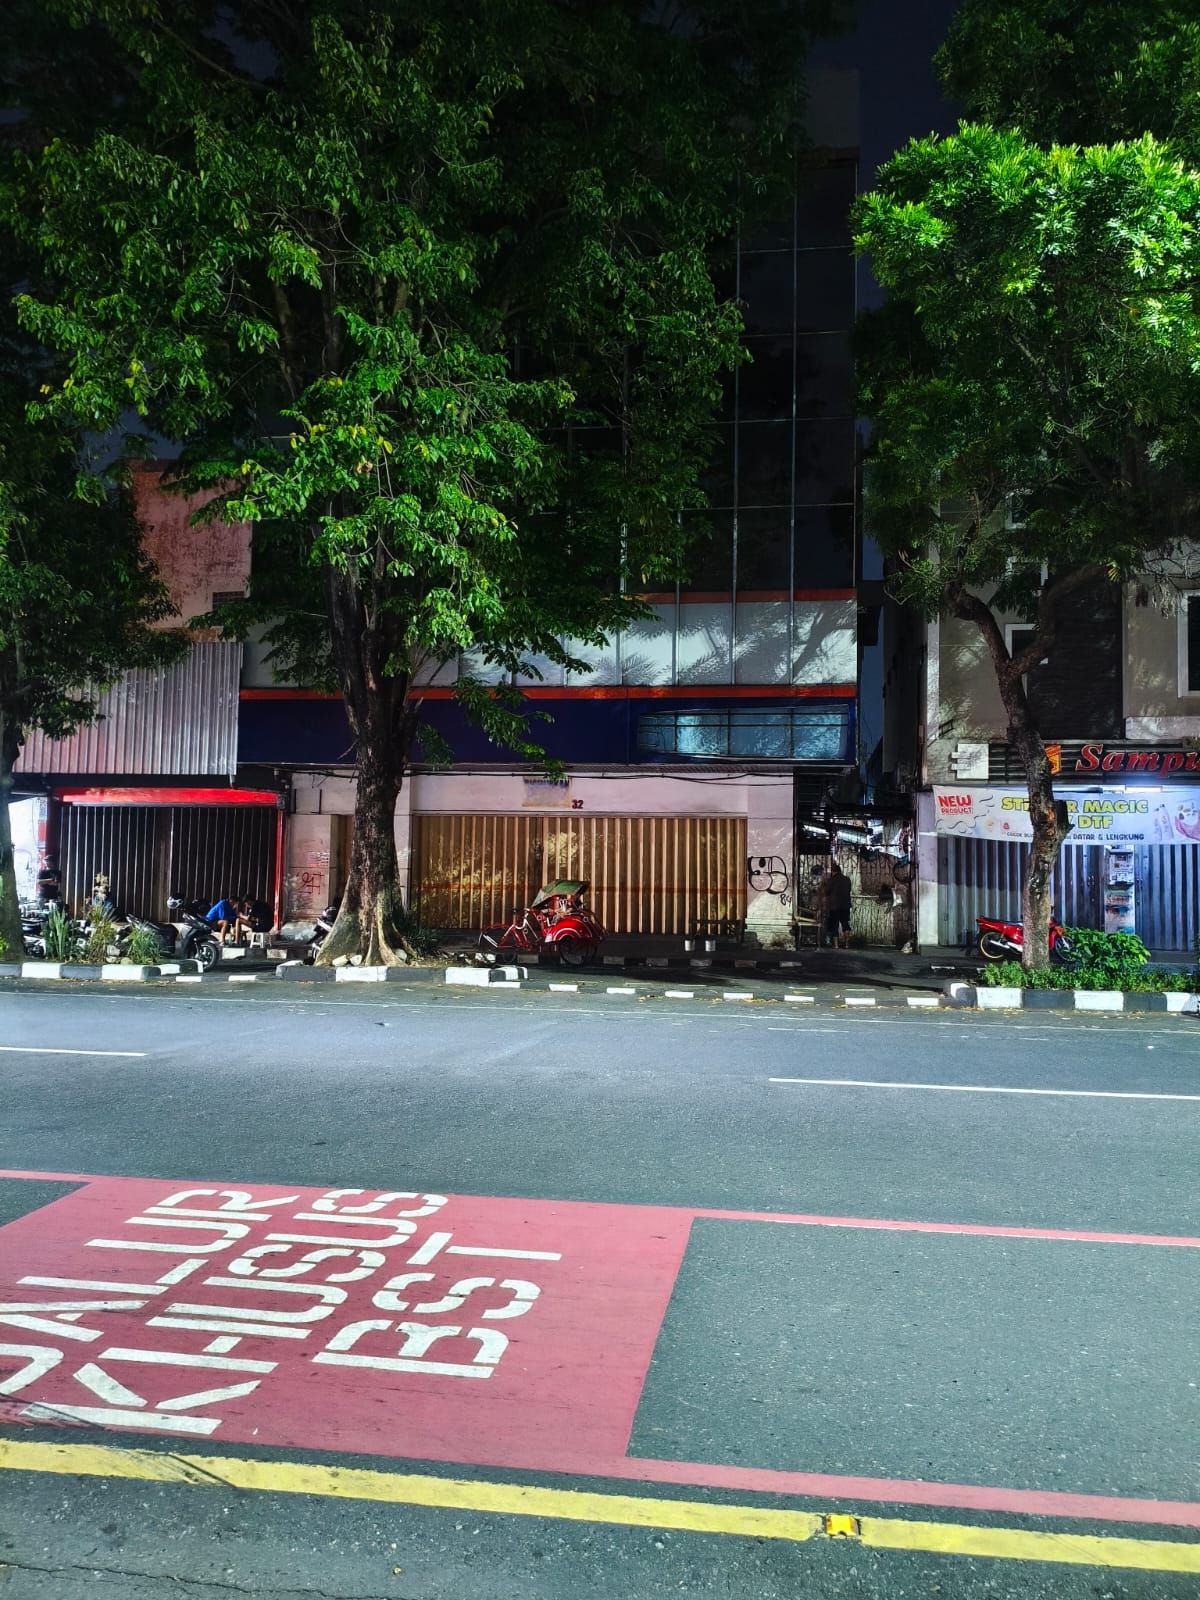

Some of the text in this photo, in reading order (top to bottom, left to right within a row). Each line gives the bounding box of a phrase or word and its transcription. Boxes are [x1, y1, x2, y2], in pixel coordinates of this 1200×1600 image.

[571, 799, 584, 809] 32
[938, 794, 972, 807] NEW
[1083, 799, 1149, 813] MAGIC
[941, 806, 972, 816] PRODUCT
[1077, 815, 1114, 829] DTF
[1073, 833, 1096, 841] DATAR
[1106, 833, 1145, 841] LENGKUNG
[20, 1187, 448, 1436] KHUSUS
[312, 1231, 562, 1379] BST
